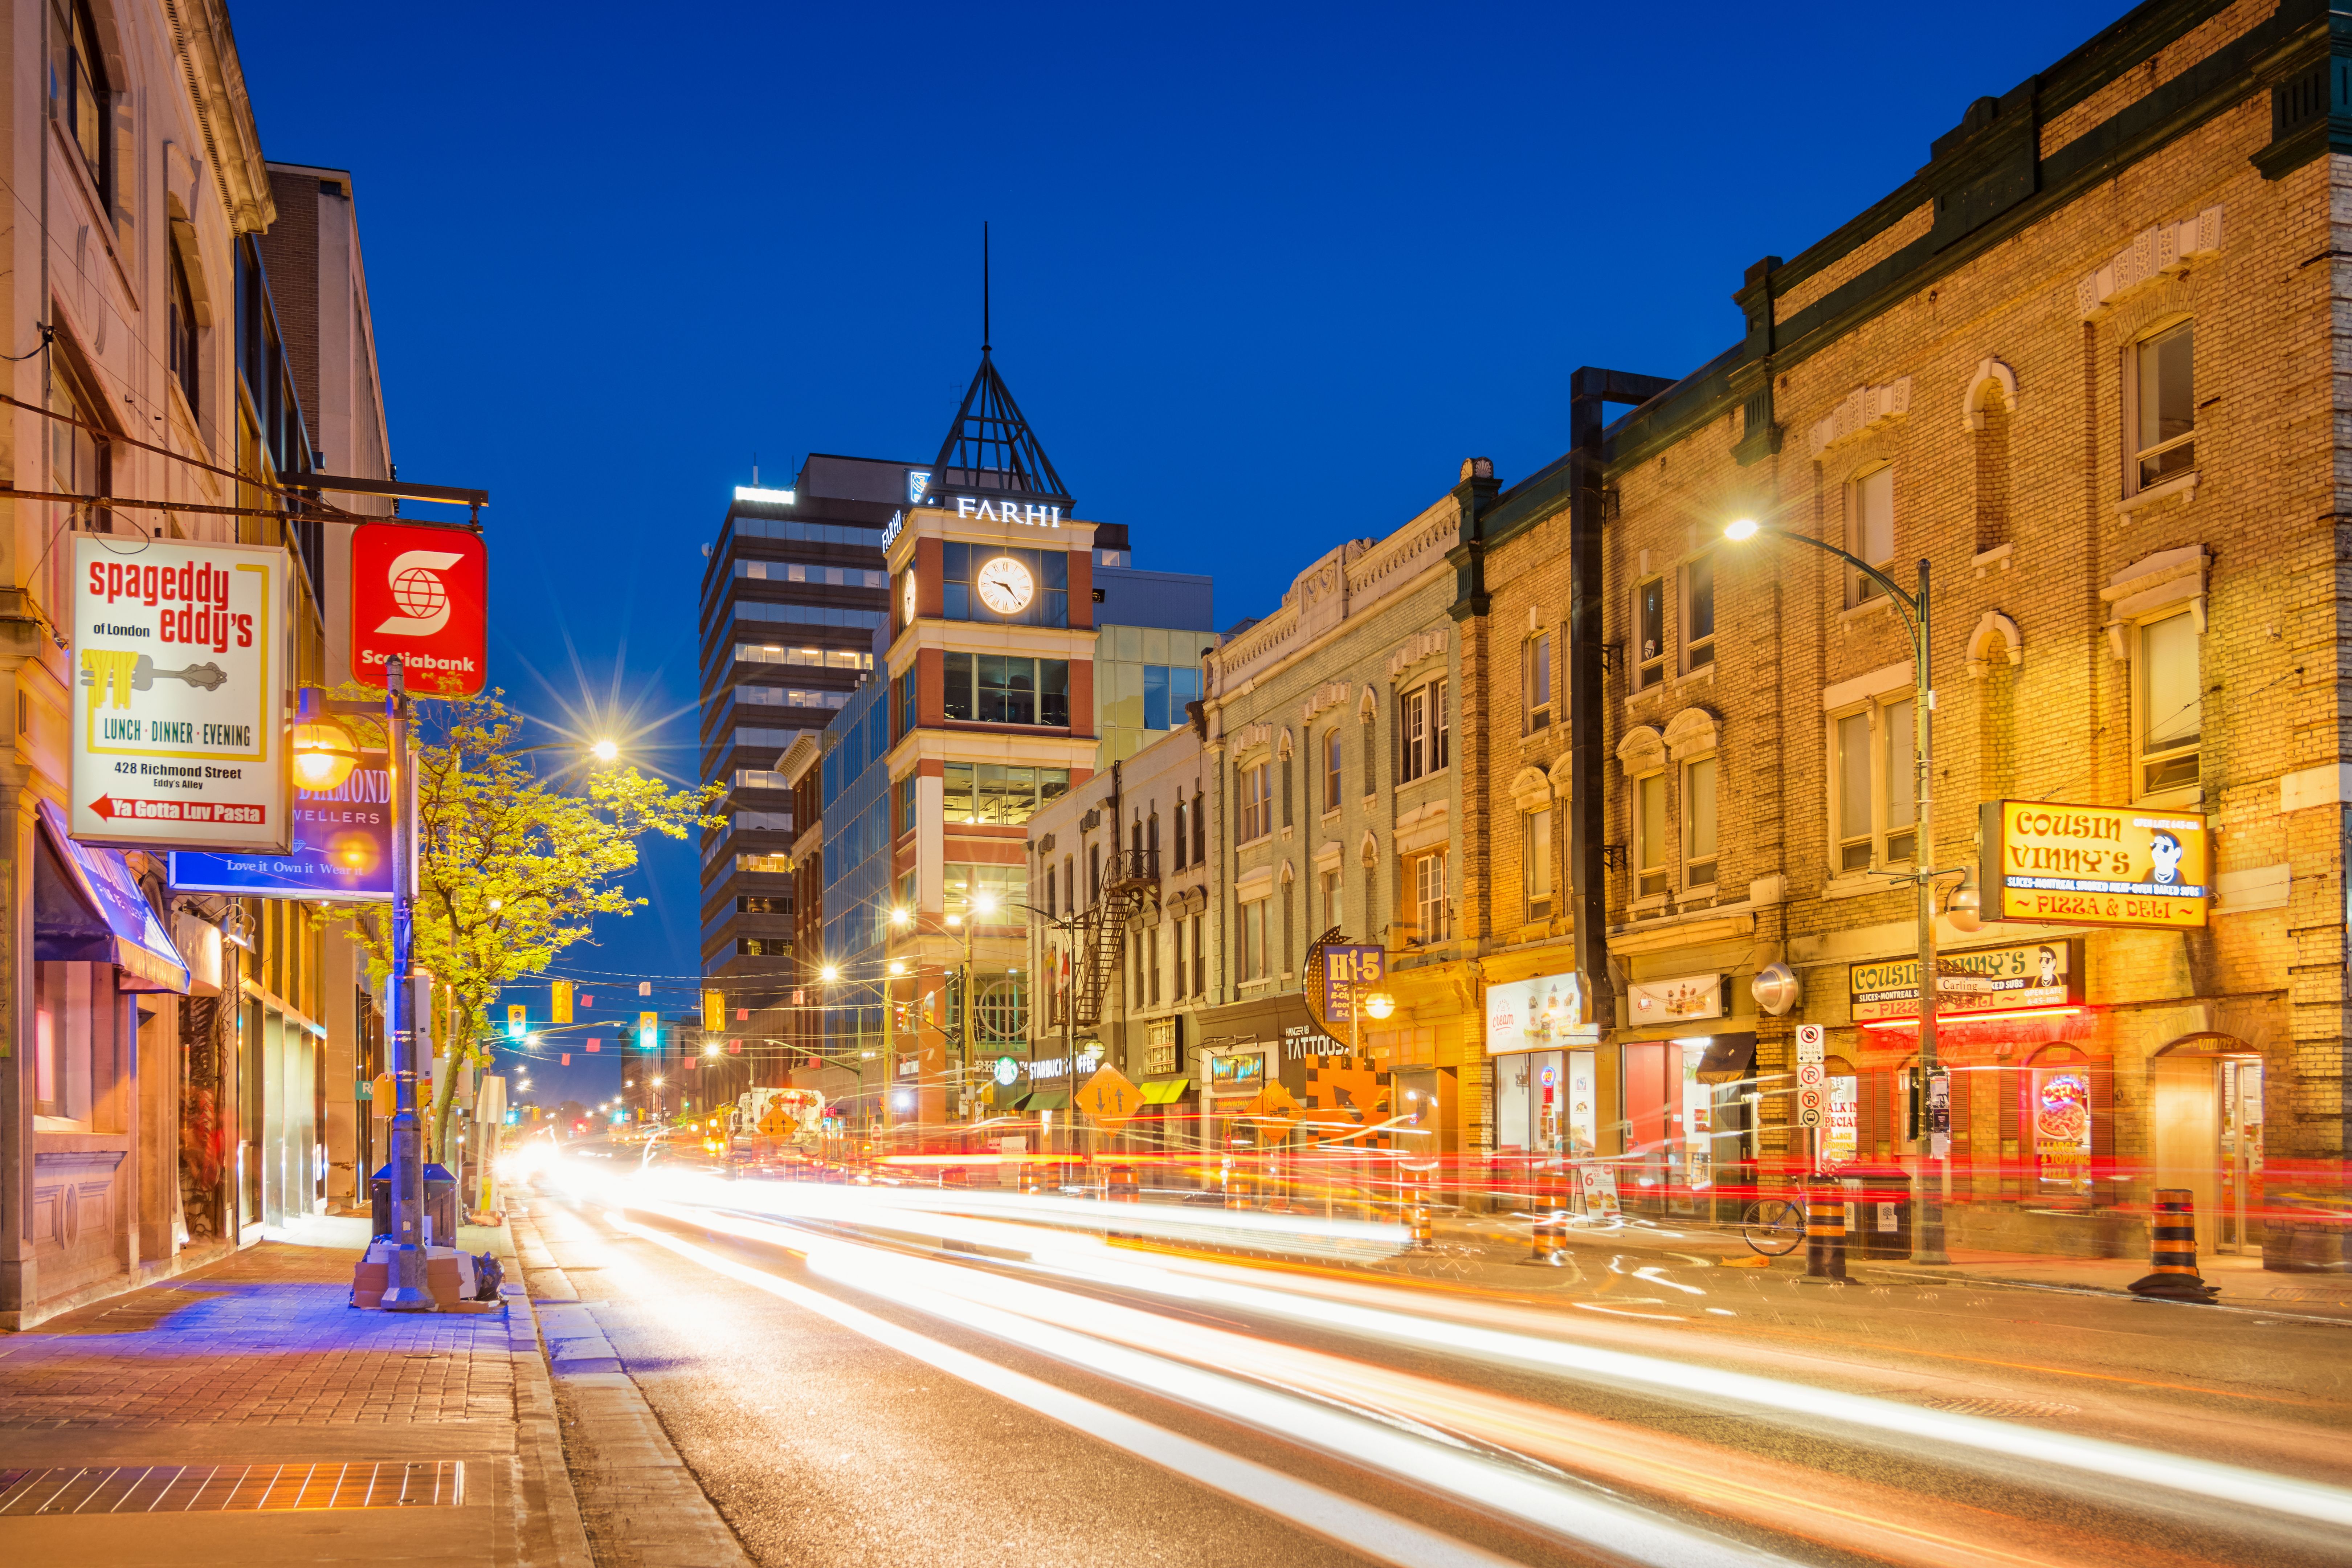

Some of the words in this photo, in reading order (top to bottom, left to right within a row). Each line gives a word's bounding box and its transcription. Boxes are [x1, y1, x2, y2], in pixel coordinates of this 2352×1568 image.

[957, 497, 1060, 528] FARHI
[882, 510, 903, 554] FARHI
[89, 560, 229, 611] spageddy
[93, 623, 106, 634] of
[107, 623, 150, 637] London
[160, 603, 253, 653] eddy's
[104, 718, 141, 741] LUNCH
[151, 720, 193, 744] DINNER
[203, 723, 250, 747] EVENING
[114, 761, 137, 774] 428
[140, 763, 202, 777] Richmond
[205, 766, 242, 779] Street
[154, 779, 180, 789] Eddy's
[182, 780, 203, 790] Alley
[112, 799, 132, 817] Ya
[135, 800, 180, 819] Gotta
[183, 803, 211, 820] Luv
[214, 804, 261, 822] Pasta
[2016, 811, 2122, 842] COUSIN
[2133, 818, 2153, 828] OPEN
[2153, 820, 2171, 829] LATE
[2009, 845, 2130, 874] VINNY'S
[227, 860, 256, 871] Love
[258, 861, 268, 871] it
[274, 862, 302, 873] Own
[305, 863, 314, 873] it
[320, 864, 351, 875] Wear
[354, 866, 363, 875] it
[2076, 881, 2108, 892] SMOKED
[2153, 884, 2180, 896] BAKED
[2180, 886, 2199, 897] SUBS
[2036, 895, 2100, 915] PIZZA
[2106, 898, 2119, 918] &
[2125, 899, 2171, 919] DELI
[1328, 949, 1380, 981] Hi-5
[1943, 980, 1978, 992] Carling
[2005, 979, 2024, 989] SUBS
[2024, 989, 2043, 997] OPEN
[2045, 987, 2063, 996] LATE
[2027, 996, 2060, 1005] 645-1116
[1879, 1001, 1919, 1017] PIZZ
[1493, 1013, 1514, 1028] cream
[2197, 1037, 2241, 1051] VINNY'S
[2046, 1141, 2078, 1153] LARGE
[1829, 1151, 1849, 1159] PIZZA
[2040, 1153, 2048, 1163] 4
[2049, 1153, 2091, 1166] TOPPING
[2041, 1167, 2070, 1178] PIZZA
